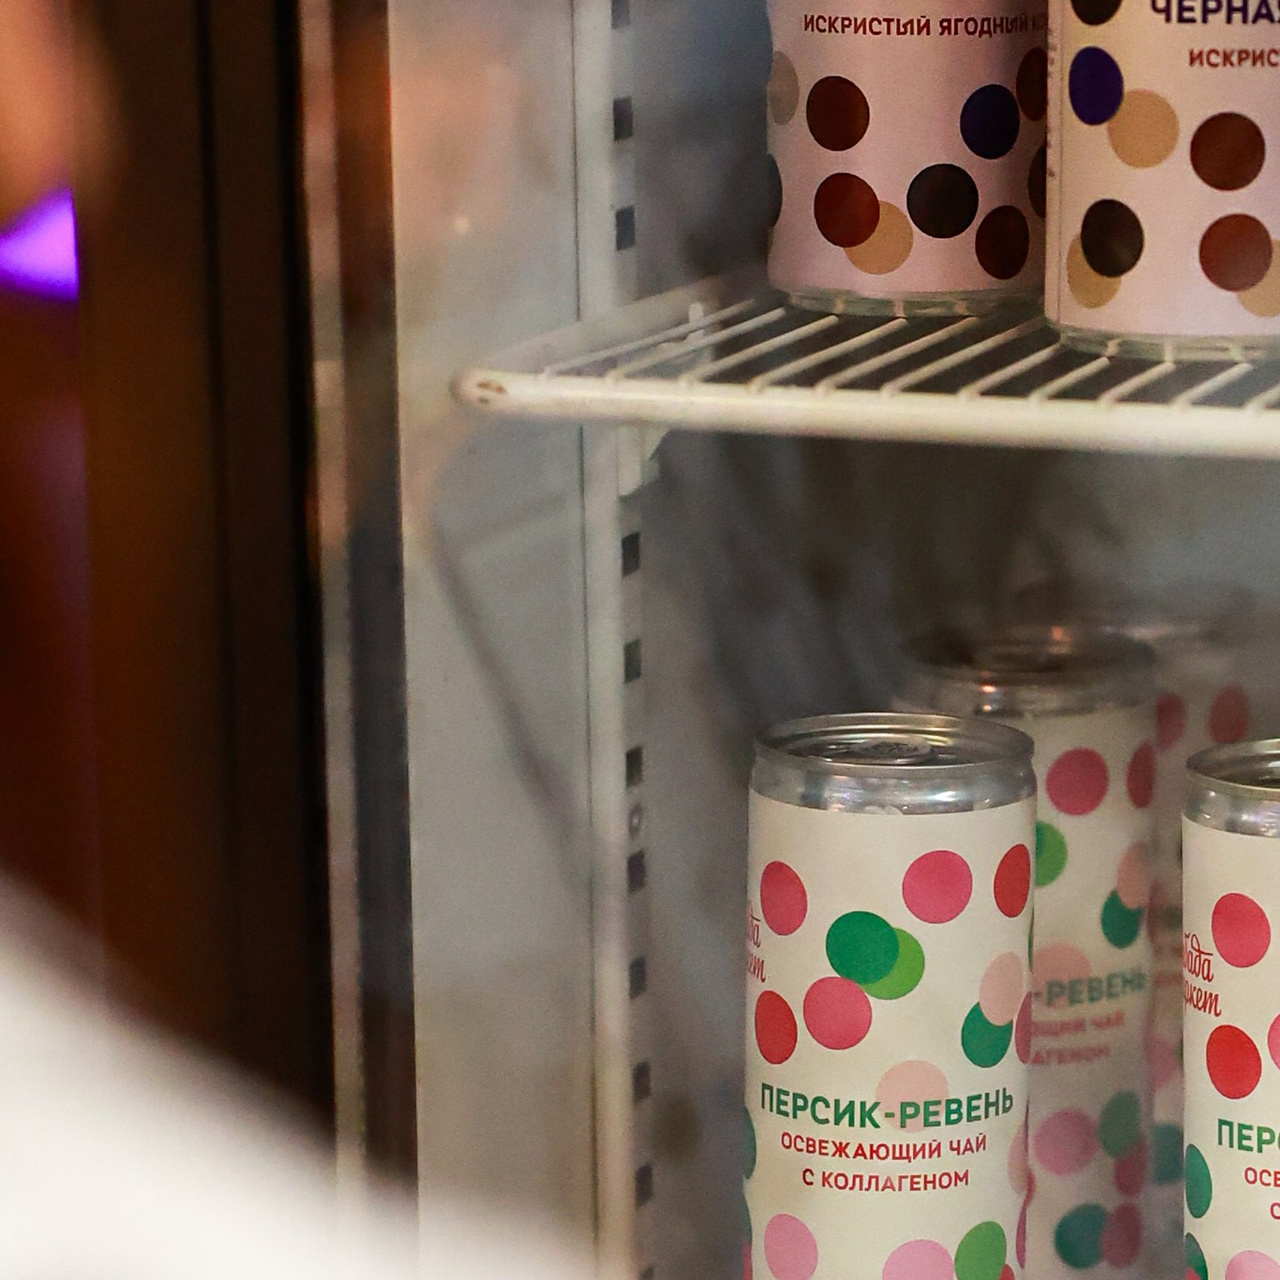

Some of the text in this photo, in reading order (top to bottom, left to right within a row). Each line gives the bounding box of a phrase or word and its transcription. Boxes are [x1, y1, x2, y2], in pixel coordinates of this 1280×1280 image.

[804, 14, 931, 36] ИСКРИСТЫЙ
[761, 1083, 1013, 1129] ПЕРСИК-РЕВЕНЬ
[781, 1131, 987, 1163] ОСВЕЖАЮЩИЙ ЧАЙ
[802, 1168, 969, 1191] С КОЛЛАГЕНОМ
